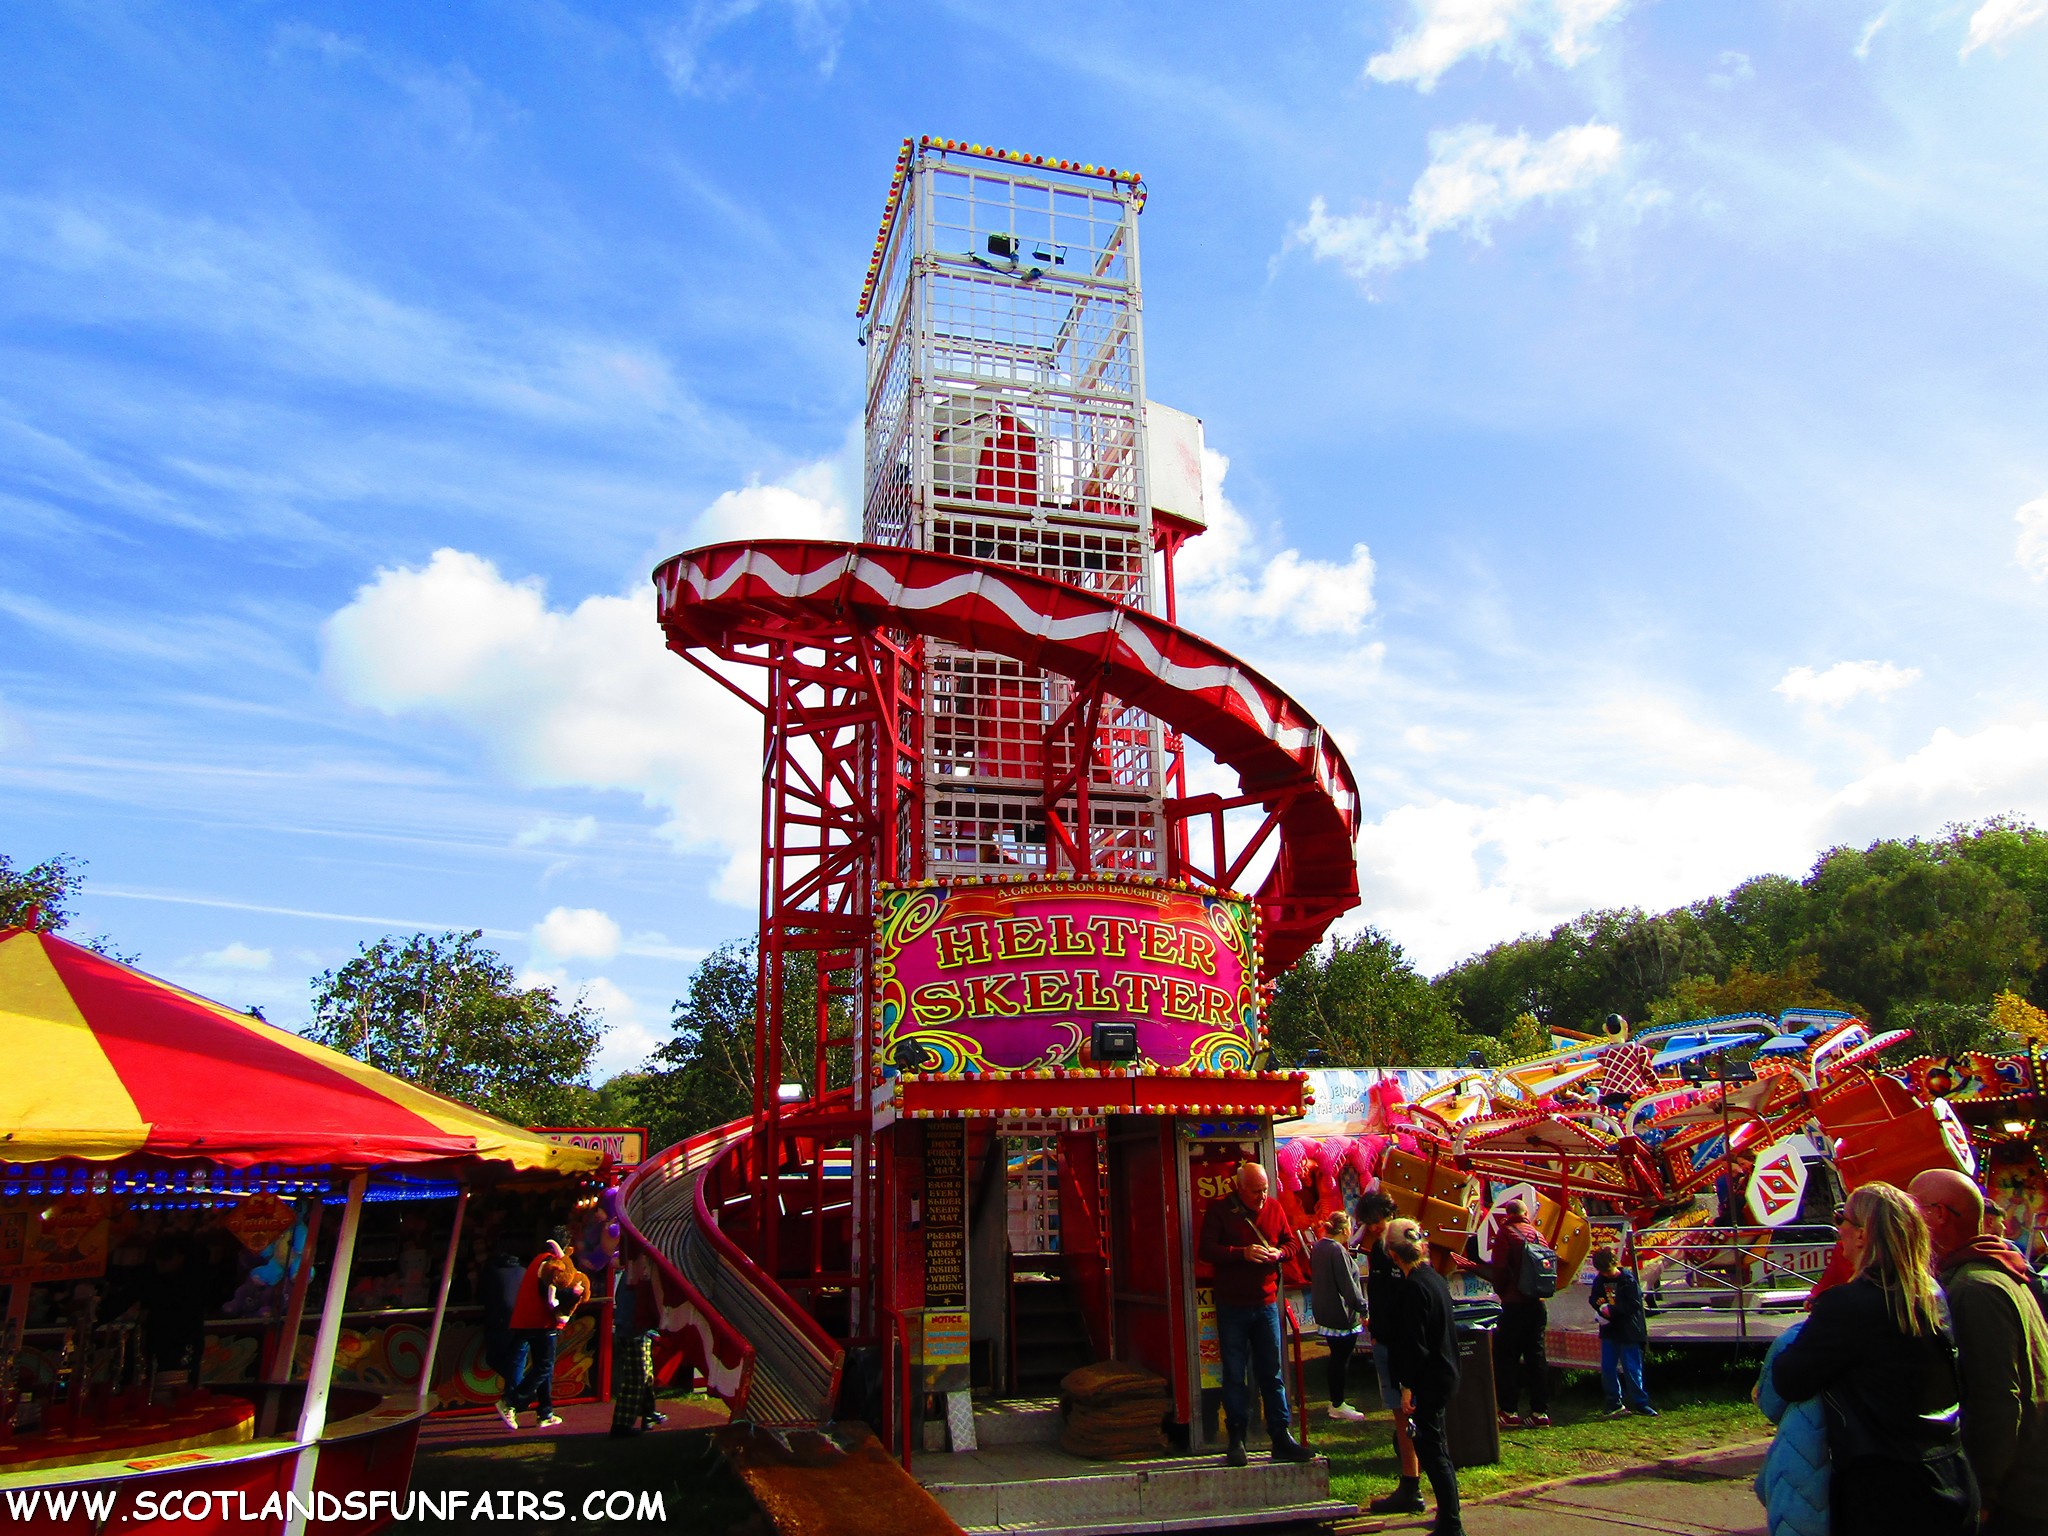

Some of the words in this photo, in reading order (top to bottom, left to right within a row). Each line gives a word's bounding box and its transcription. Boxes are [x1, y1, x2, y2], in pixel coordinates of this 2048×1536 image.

[998, 884, 1052, 898] A.CRICK
[1056, 883, 1063, 891] &
[1067, 883, 1095, 892] SON
[1099, 884, 1105, 892] &
[1109, 885, 1170, 904] DAUGHTER
[931, 914, 1217, 976] HELTER
[910, 969, 1237, 1032] SKELTER
[1334, 1102, 1366, 1114] SHRIMP
[932, 1158, 956, 1166] YOUR
[928, 1181, 953, 1189] EACH
[927, 1198, 961, 1206] SLIDER
[929, 1206, 960, 1214] NEEDS
[927, 1232, 963, 1240] PLEASE
[931, 1240, 958, 1248] KEEP
[927, 1249, 954, 1257] ARMS
[932, 1257, 957, 1265] LEGS
[929, 1265, 960, 1273] INSIDE
[931, 1274, 958, 1282] WHEN
[927, 1282, 964, 1291] SLIDING
[931, 1315, 962, 1324] NOTICE
